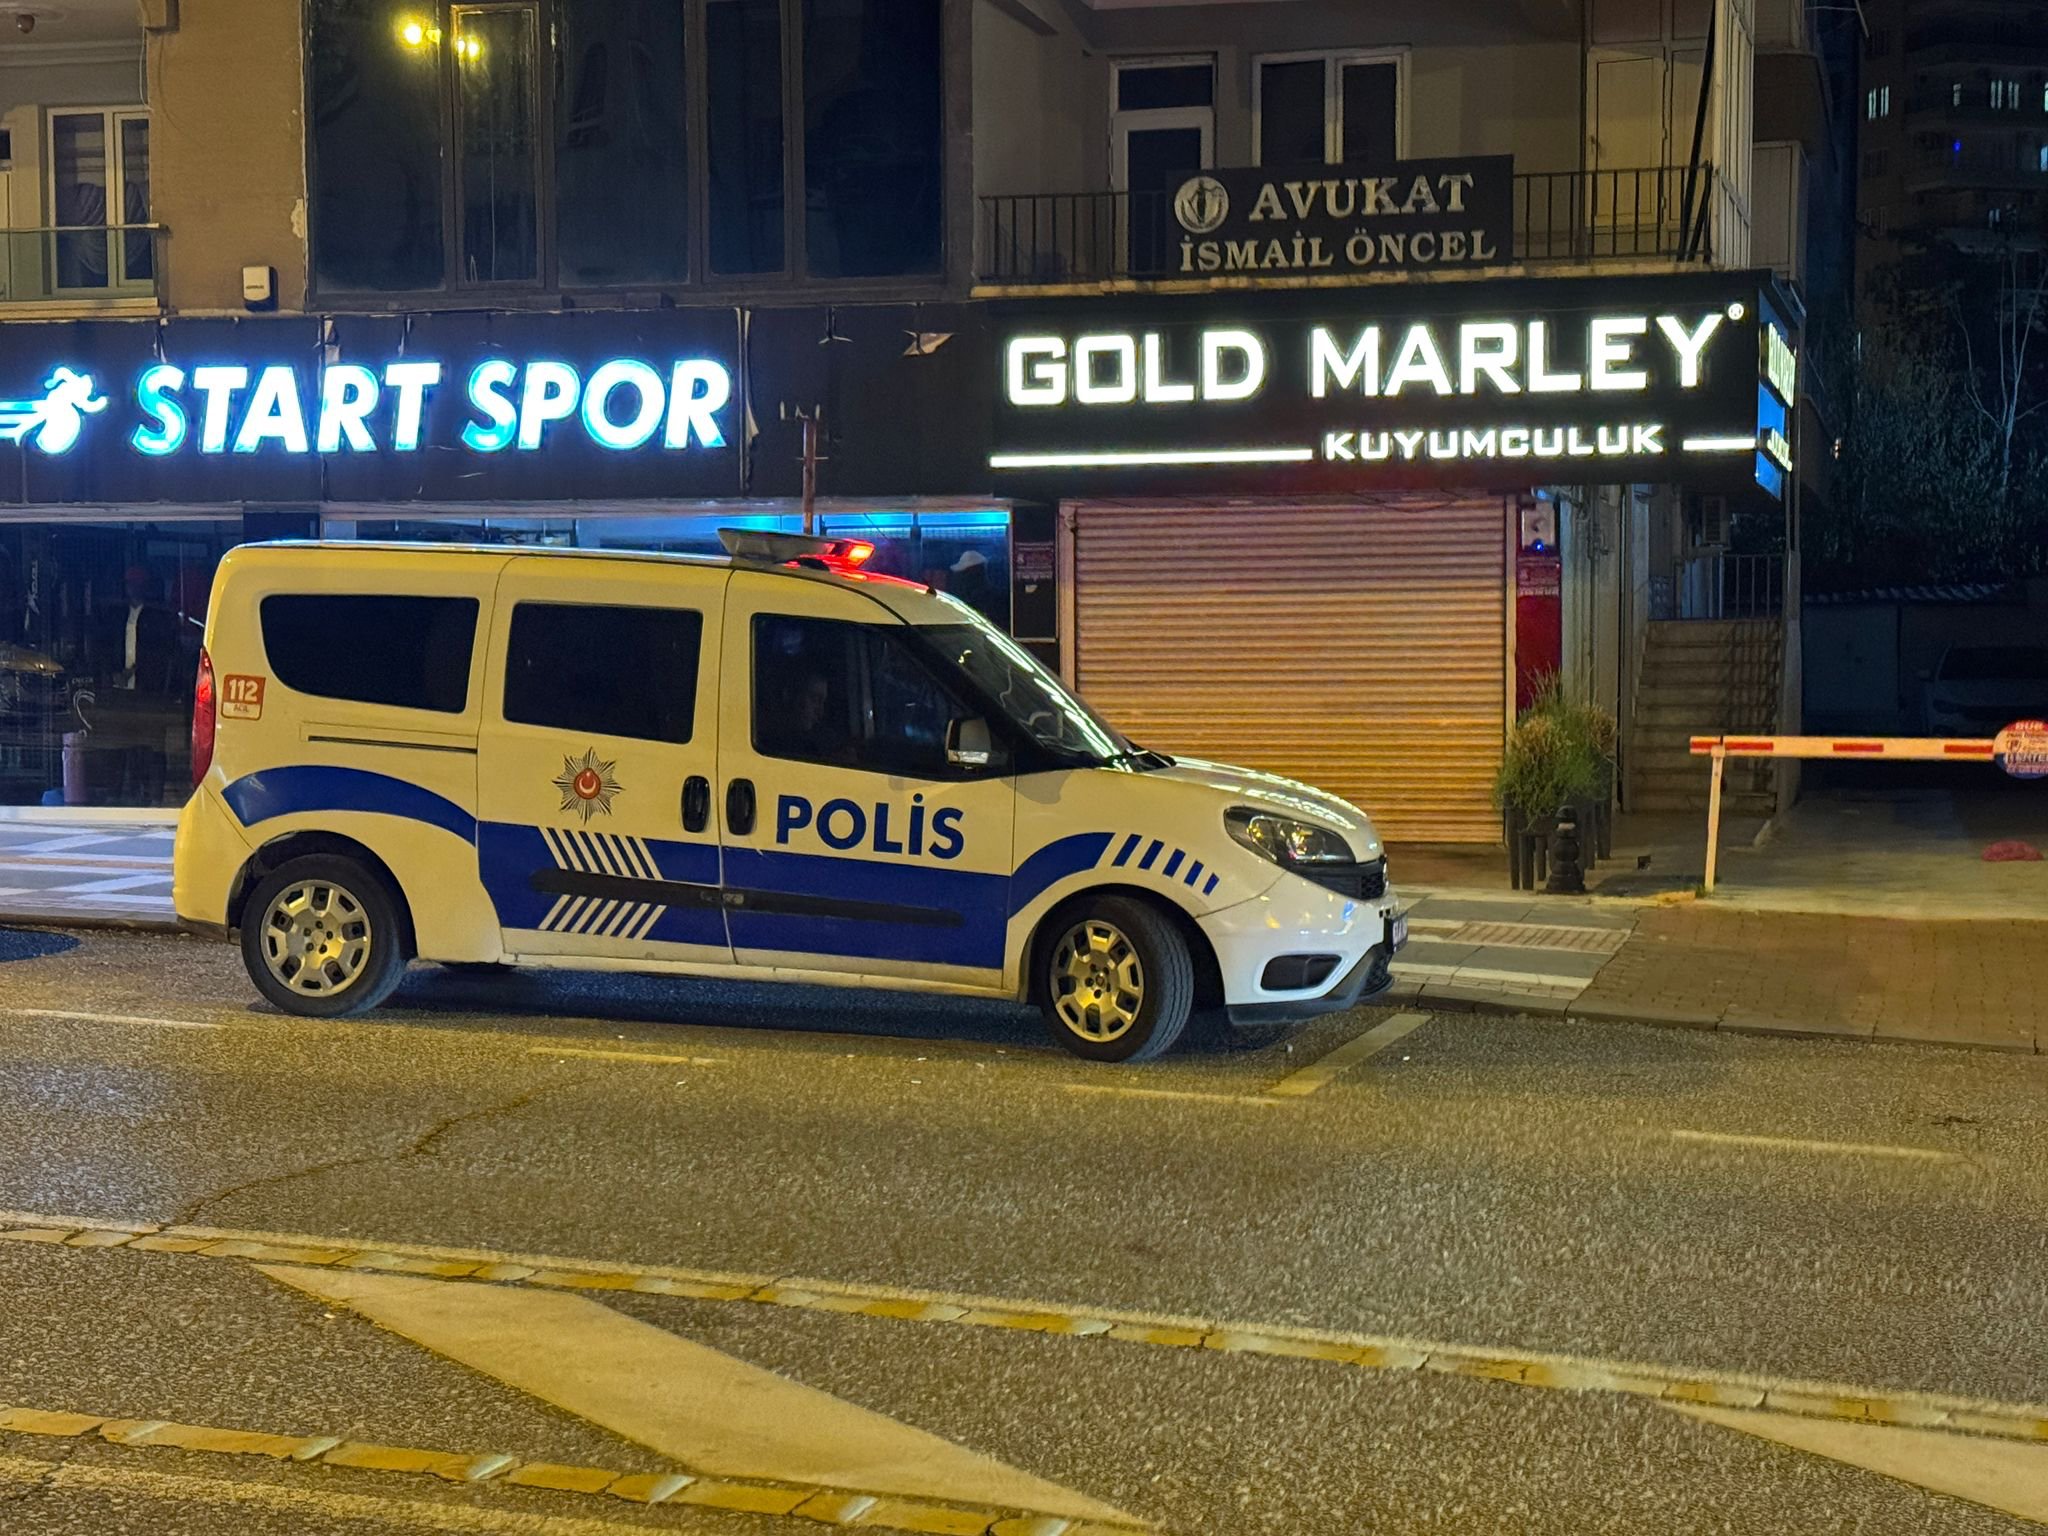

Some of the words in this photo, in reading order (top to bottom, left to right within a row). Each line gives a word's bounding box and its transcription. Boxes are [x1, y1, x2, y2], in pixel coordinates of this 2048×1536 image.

[1249, 173, 1474, 221] AVUKAT
[1179, 231, 1333, 271] İSMAİL
[1345, 227, 1496, 265] ÖNCEL
[1007, 329, 1265, 405] GOLD
[1311, 314, 1723, 397] MARLEY
[132, 362, 441, 455] START
[462, 359, 730, 452] SPOR
[1325, 424, 1664, 461] KUYUMCULUK
[229, 678, 258, 702] 112
[776, 793, 965, 859] POLİS
